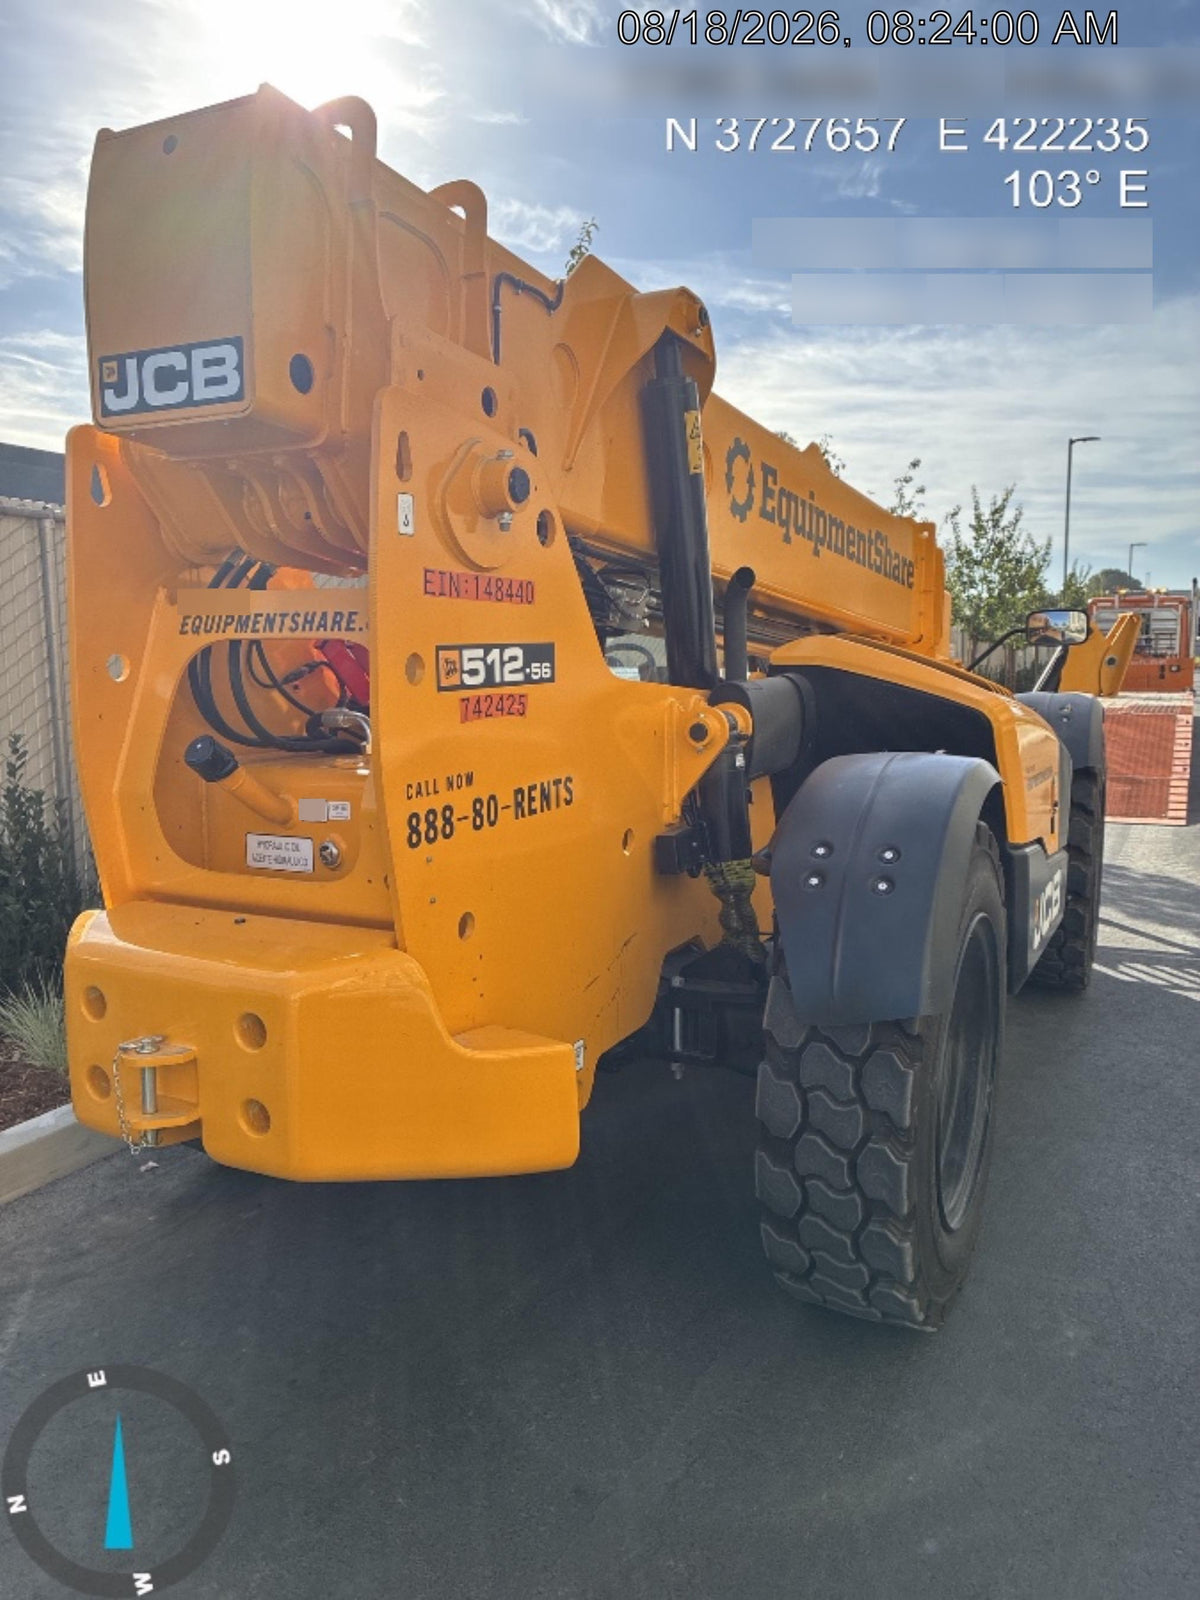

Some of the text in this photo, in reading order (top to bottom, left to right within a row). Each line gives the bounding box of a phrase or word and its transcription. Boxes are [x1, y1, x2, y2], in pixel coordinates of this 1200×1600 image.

[104, 344, 241, 412] JCB
[758, 461, 916, 589] EquipmentShare
[423, 568, 535, 604] EIN:148440
[461, 694, 527, 724] 742425
[406, 771, 474, 800] CALL NOW
[407, 776, 573, 849] 888-80-RENTS
